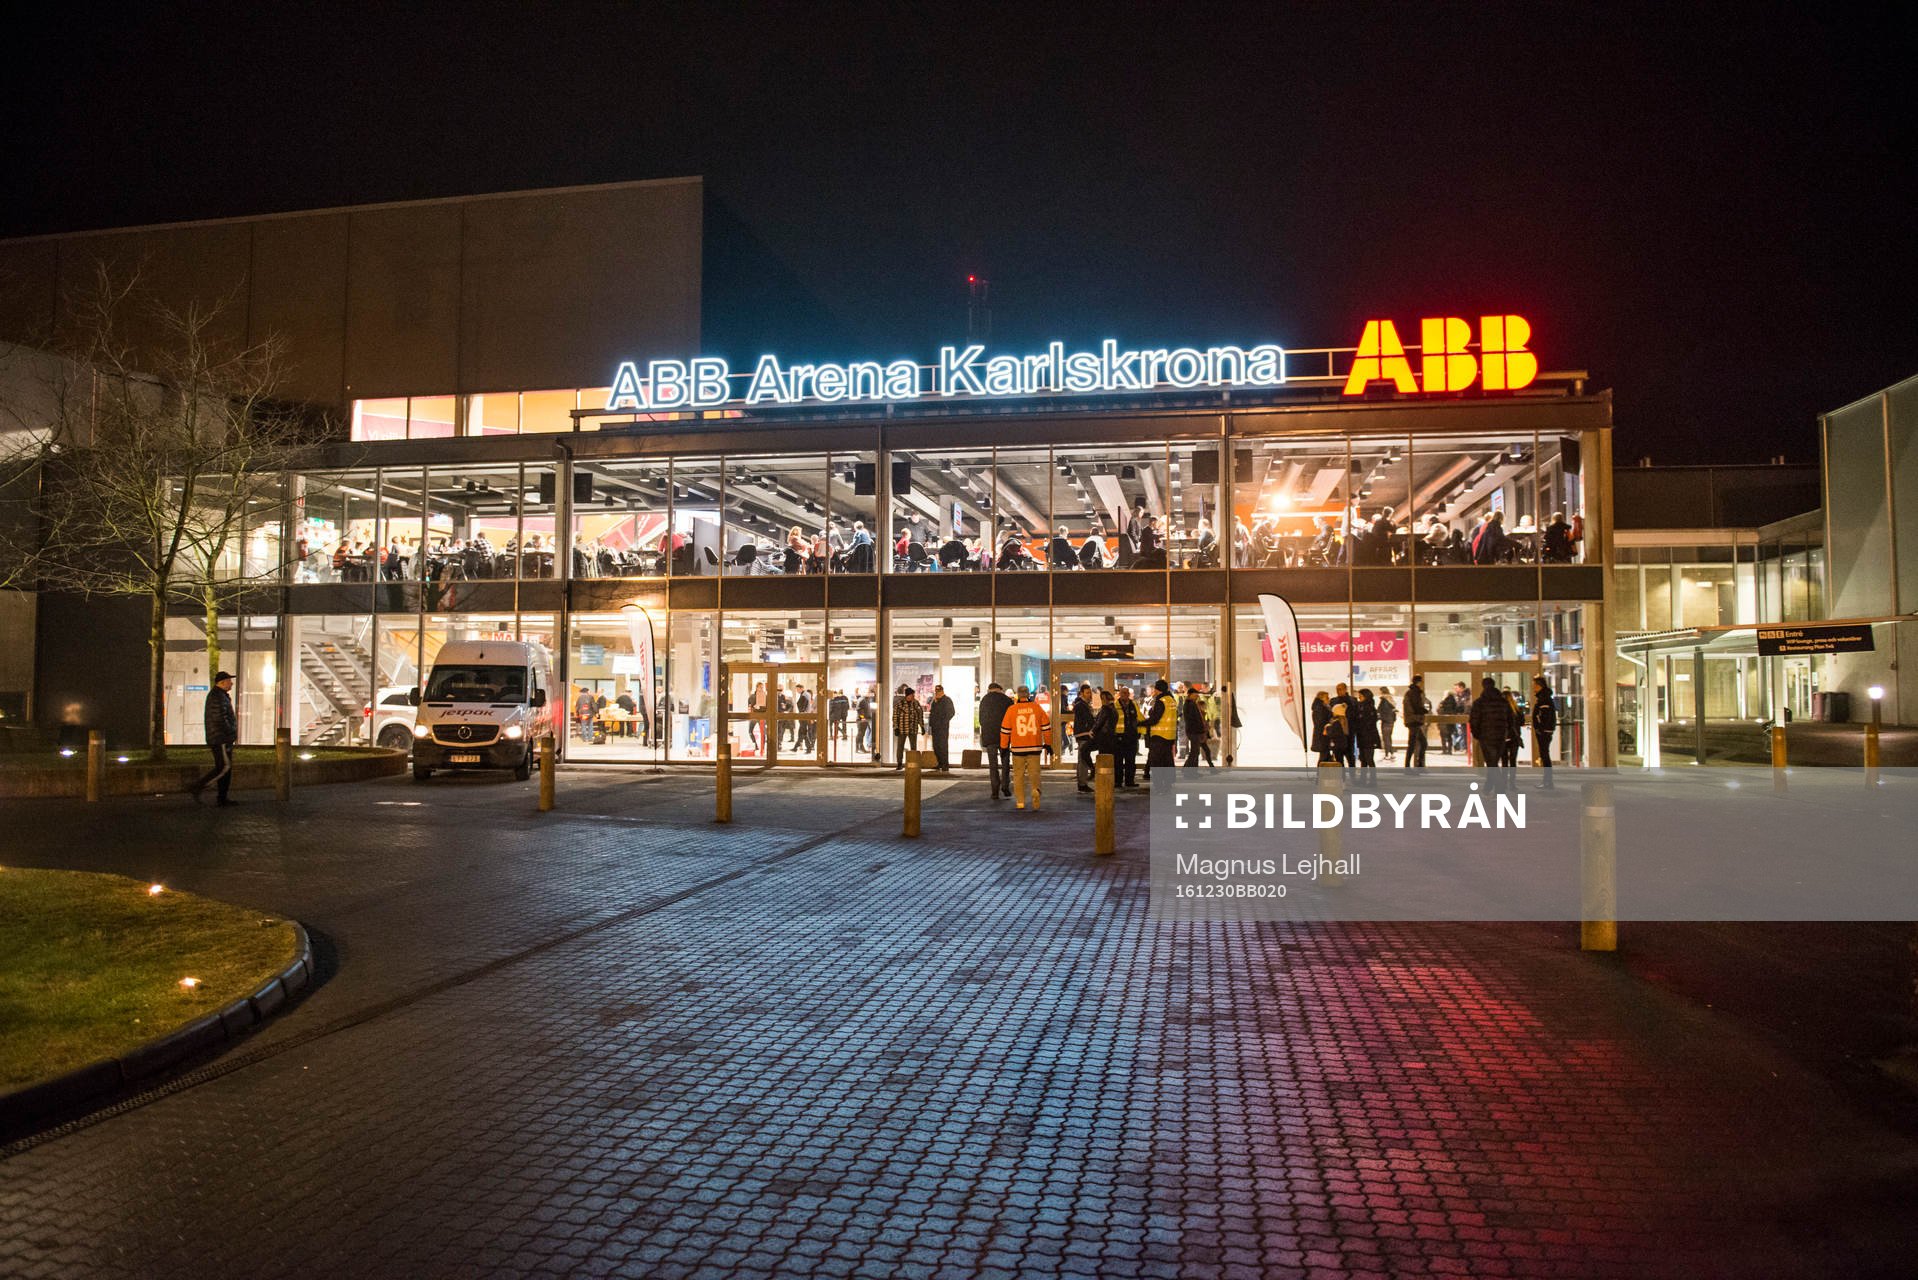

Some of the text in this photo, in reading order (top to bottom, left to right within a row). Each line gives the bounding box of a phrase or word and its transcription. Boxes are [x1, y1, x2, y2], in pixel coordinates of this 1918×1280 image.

[606, 339, 1287, 411] ABB Arena Karlskrona
[1342, 315, 1538, 395] ABB
[440, 708, 496, 718] jetpak
[1016, 714, 1037, 736] 64
